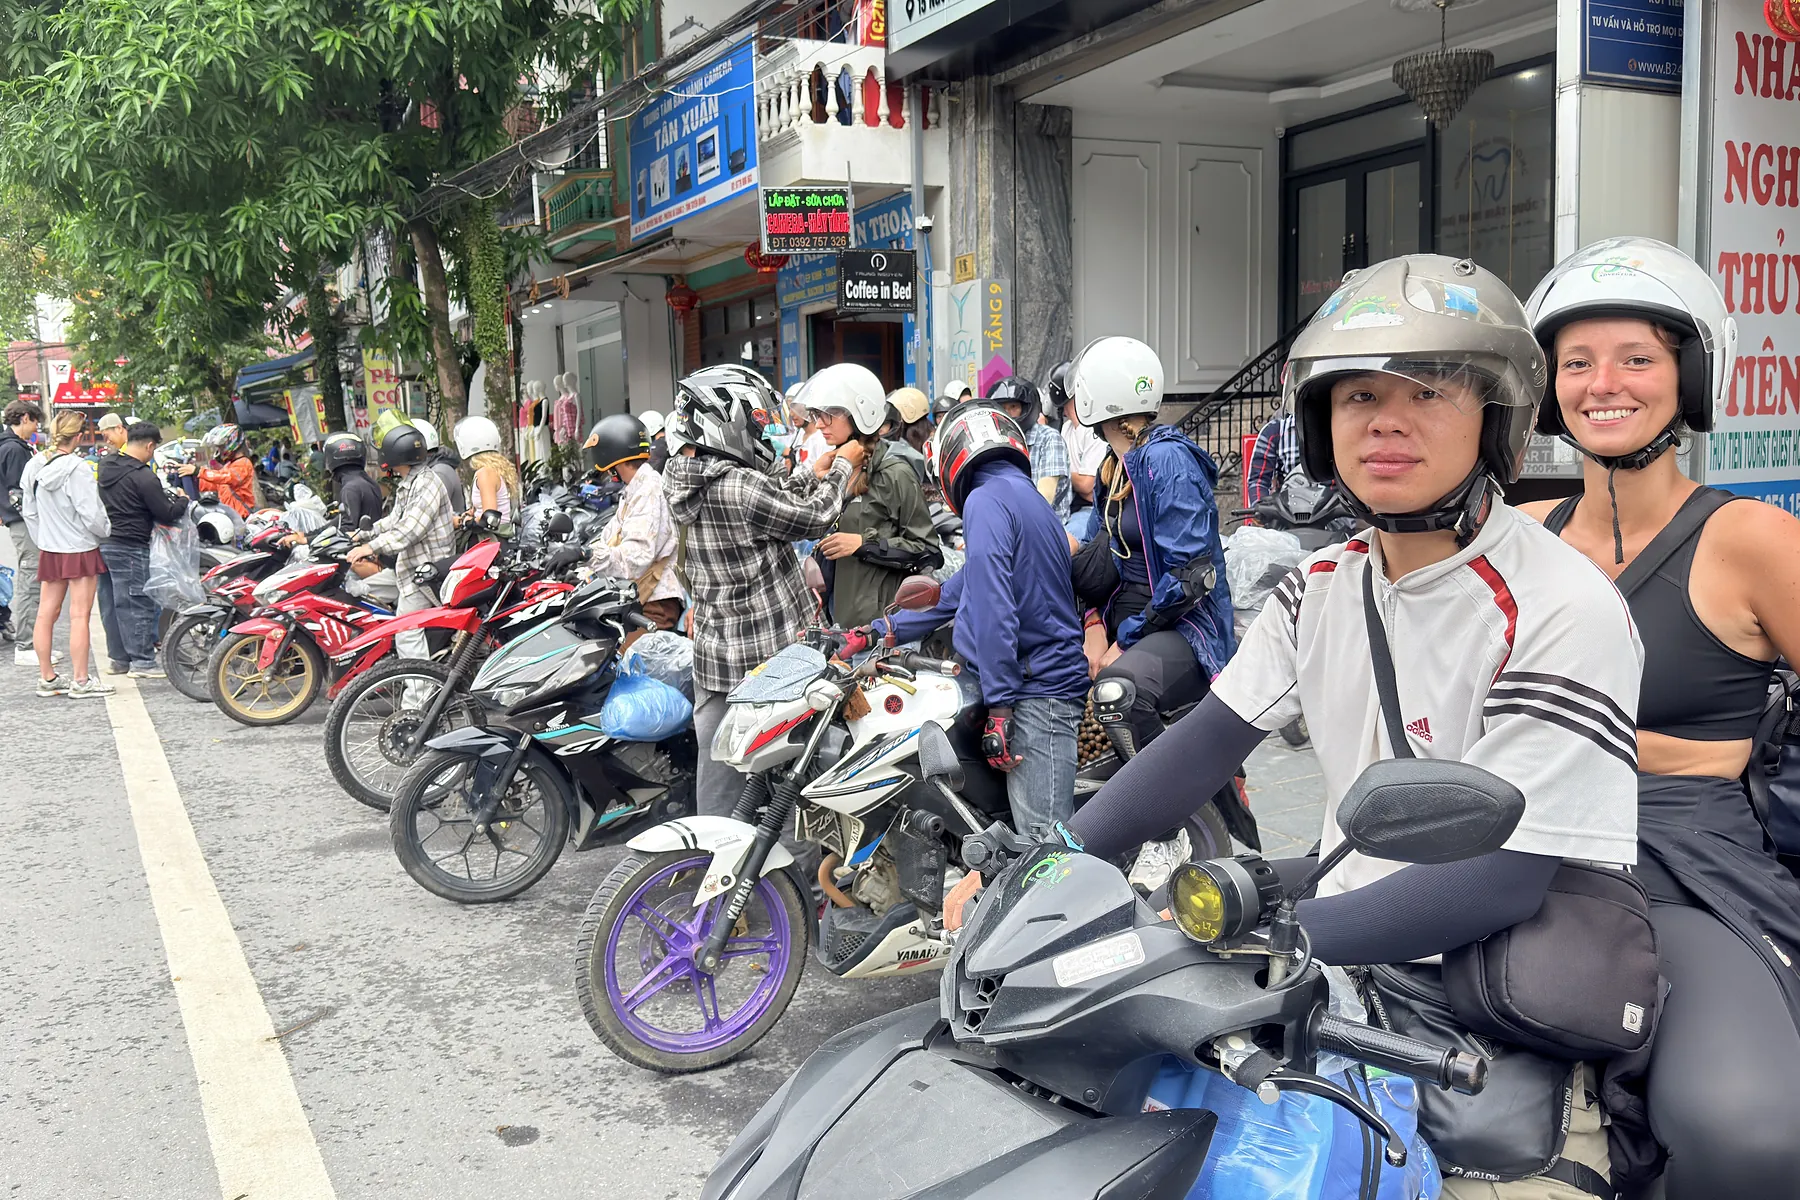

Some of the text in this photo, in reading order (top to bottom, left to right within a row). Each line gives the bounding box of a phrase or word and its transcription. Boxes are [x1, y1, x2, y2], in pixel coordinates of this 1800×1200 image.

[1621, 18, 1632, 31] VÀ
[704, 58, 733, 89] CAMERA
[654, 93, 719, 152] TÂN XUÂN
[768, 192, 783, 207] LẮP
[784, 193, 801, 208] ĐẶT
[805, 193, 822, 207] SỬA
[822, 194, 845, 207] CHỮA
[767, 213, 805, 234] CAMERA
[772, 236, 847, 248] ĐT: 0392 757 326
[845, 279, 879, 299] Coffee
[880, 281, 890, 299] in
[892, 281, 912, 300] Bed
[983, 283, 1003, 352] TẦNG 9
[1709, 431, 1727, 471] THUY
[1728, 431, 1743, 470] TIEN
[1744, 430, 1770, 469] TOURIST
[1771, 429, 1792, 468] GUEST
[545, 723, 571, 733] HONDA
[1406, 724, 1433, 743] adidas
[1561, 1087, 1573, 1136] MOTOWOLF
[1450, 1166, 1500, 1182] MOTOWLF
